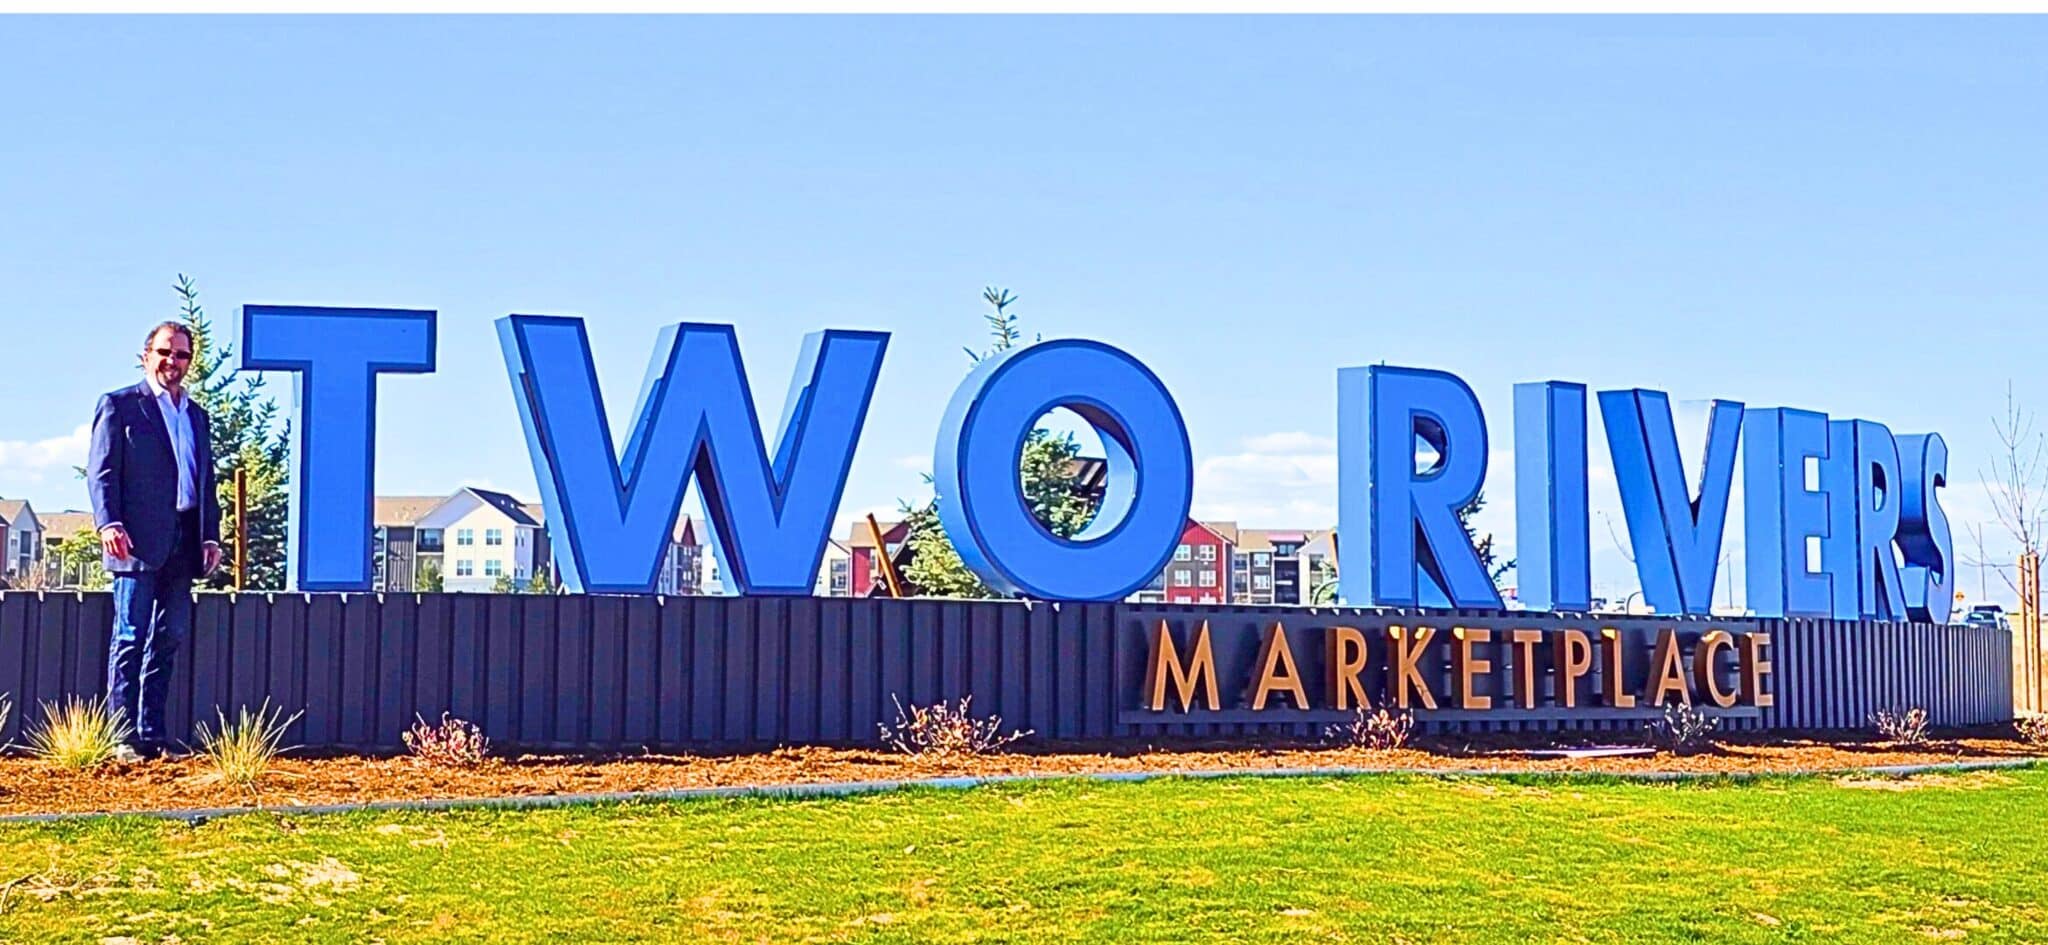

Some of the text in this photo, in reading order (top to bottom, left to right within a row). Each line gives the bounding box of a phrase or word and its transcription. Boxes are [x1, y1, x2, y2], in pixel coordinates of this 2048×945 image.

[239, 304, 1954, 625] TWO RIVERS
[1147, 618, 1774, 713] MARKETPLACE
